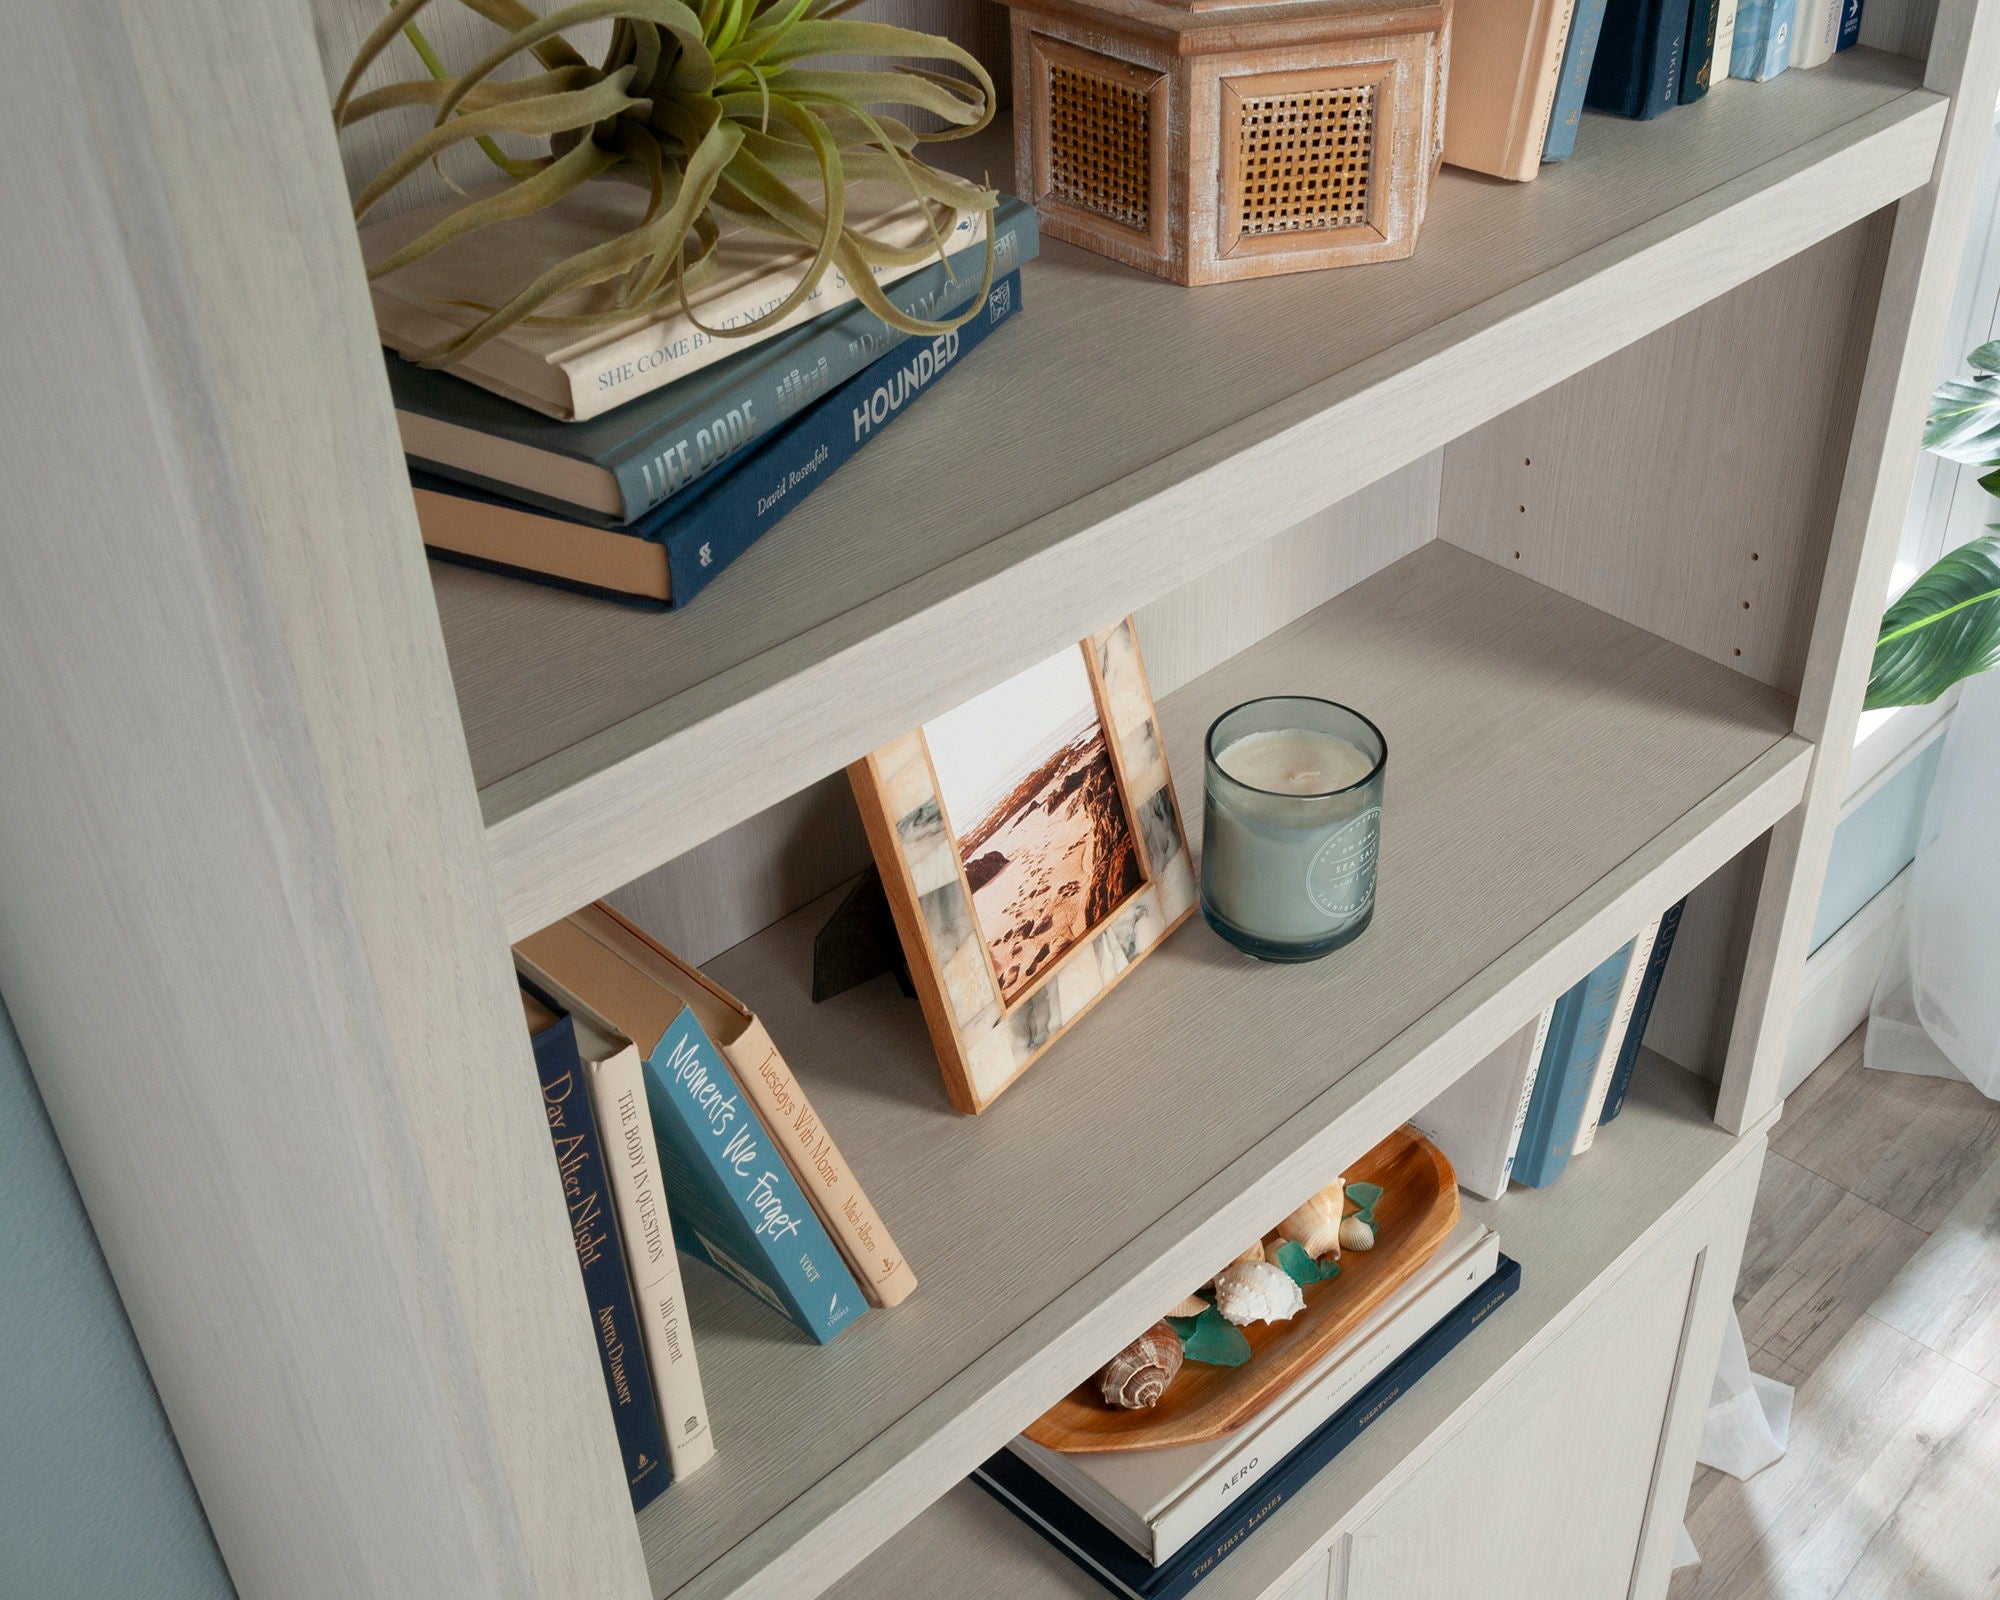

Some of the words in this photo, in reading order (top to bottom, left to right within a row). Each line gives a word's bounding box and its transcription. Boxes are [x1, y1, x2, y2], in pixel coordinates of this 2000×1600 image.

[1664, 36, 1680, 101] VIKING
[597, 362, 634, 391] SHE
[636, 338, 691, 373] COME
[720, 314, 740, 331] IT
[852, 329, 960, 442] HOUNDED
[642, 439, 693, 506] LIFE
[696, 399, 757, 471] CODE
[757, 477, 787, 517] David
[788, 443, 829, 489] Rosenfelt
[1335, 860, 1356, 874] SEA
[1360, 842, 1377, 861] SALT
[1618, 962, 1647, 1029] IGNORE
[542, 1070, 573, 1128] Day
[618, 1089, 637, 1127] THE
[758, 1047, 795, 1116] Tuesdays
[793, 1104, 819, 1148] With
[1518, 1068, 1537, 1129] CONNOR
[555, 1134, 590, 1199] After
[625, 1125, 646, 1169] BODY
[666, 1033, 738, 1135] Moments
[722, 1123, 758, 1177] We
[746, 1171, 802, 1242] Forget
[633, 1169, 650, 1189] IN
[570, 1191, 608, 1270] Night
[636, 1189, 665, 1265] QUESTION
[855, 1222, 876, 1253] Albom
[798, 1253, 821, 1283] VOGT
[660, 1297, 676, 1320] Jill
[598, 1305, 617, 1348] ANITA
[608, 1342, 632, 1406] DIAMANT
[664, 1318, 683, 1365] Ciment
[1359, 1387, 1399, 1426] SHERWOOD
[1221, 1457, 1259, 1495] AERO
[1191, 1557, 1214, 1579] THE
[1216, 1527, 1246, 1558] FIRST
[1248, 1494, 1281, 1529] LADIES
